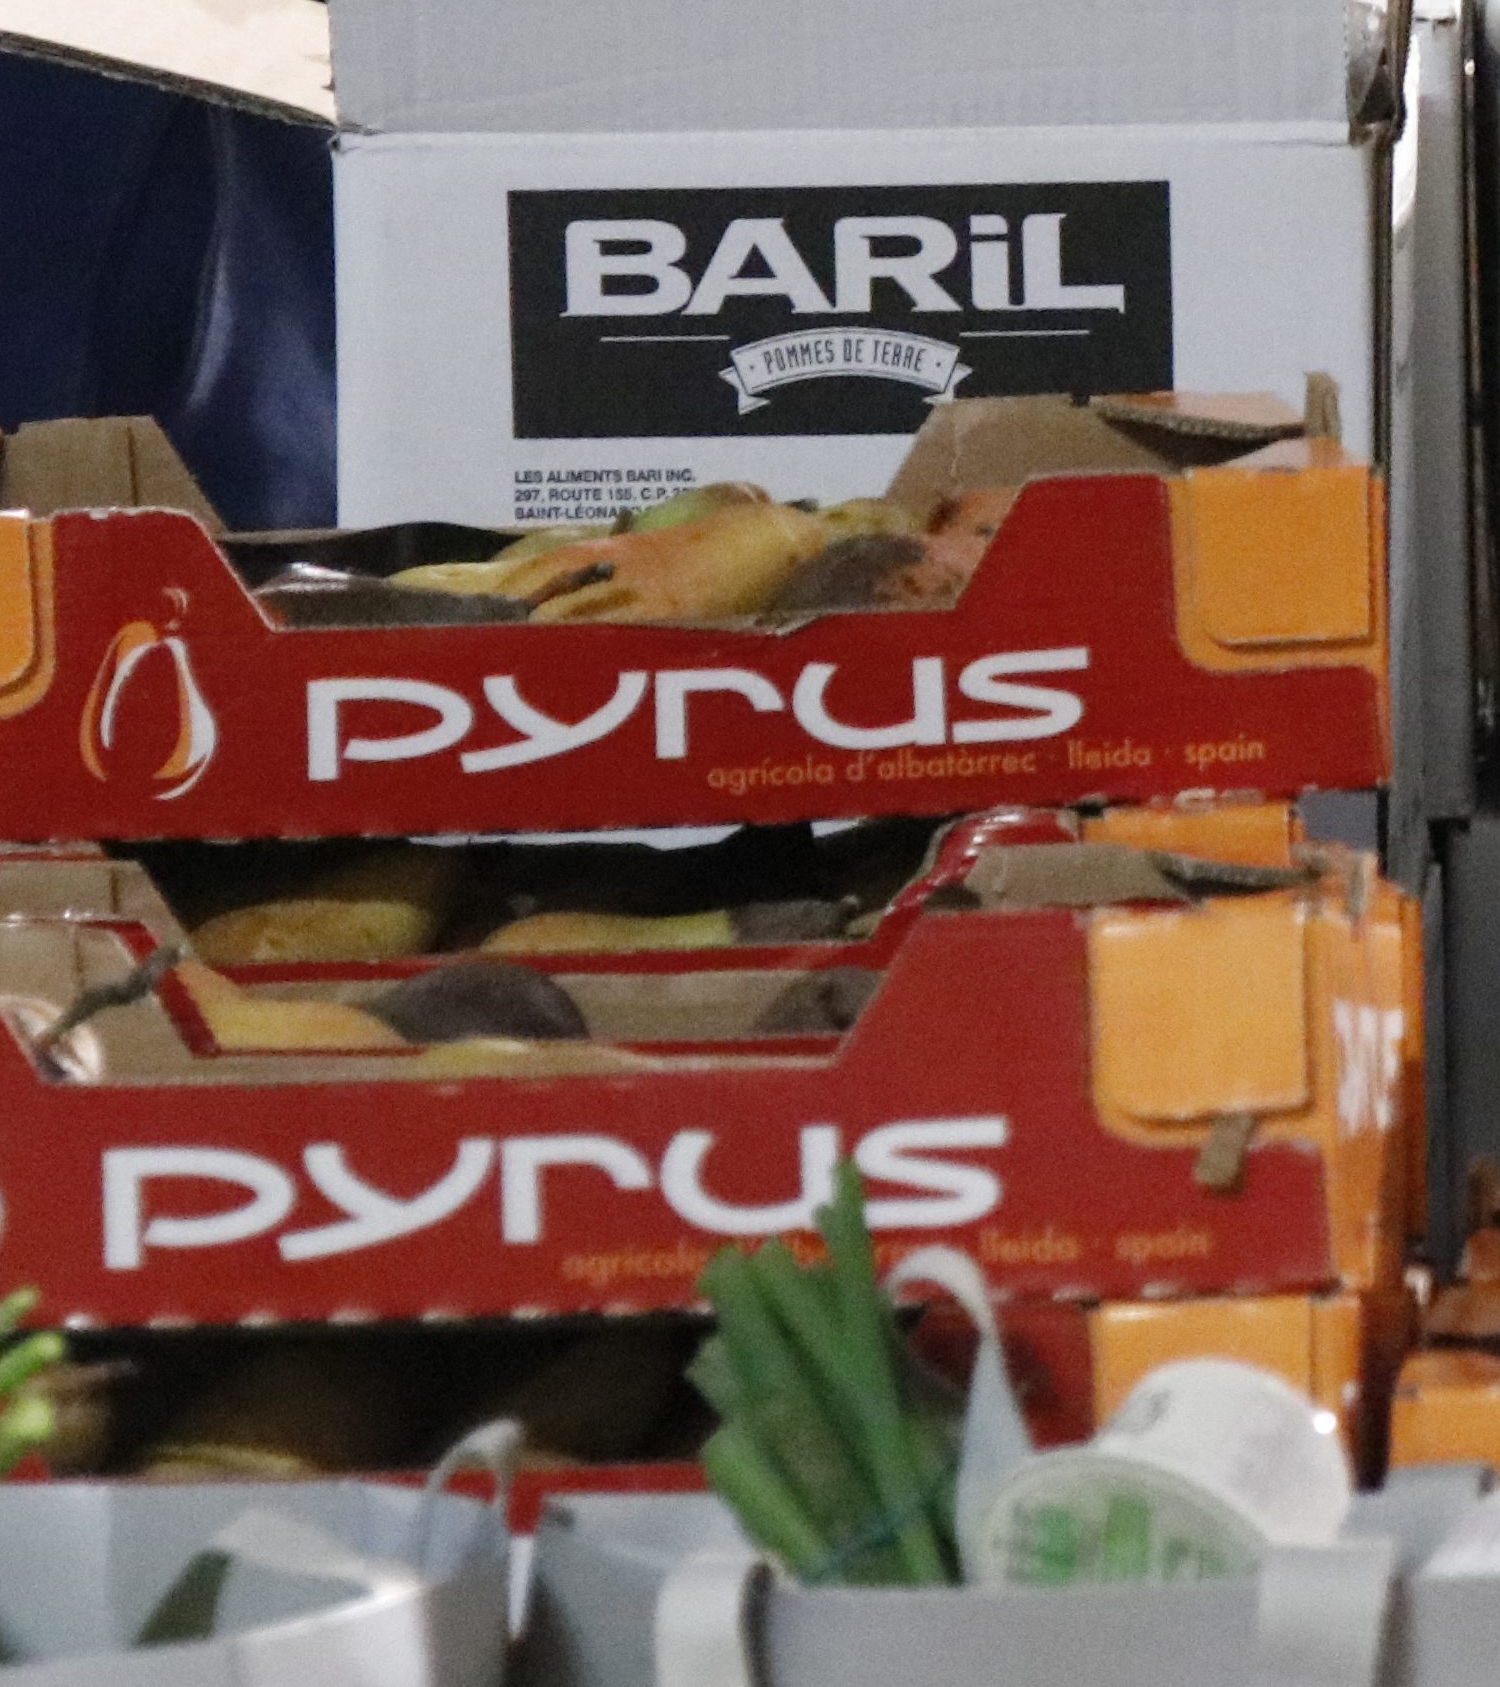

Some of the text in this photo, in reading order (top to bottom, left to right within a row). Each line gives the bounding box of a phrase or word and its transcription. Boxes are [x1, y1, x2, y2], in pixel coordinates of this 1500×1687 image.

[764, 337, 925, 373] POMMES DE TERRE
[514, 468, 696, 483] LES ALIMENTS BARI INC.
[548, 488, 603, 502] ROUTE
[308, 647, 1089, 782] pyrus
[1067, 739, 1153, 770] lleida
[1184, 735, 1265, 772] spain
[103, 1115, 1009, 1272] pyrus
